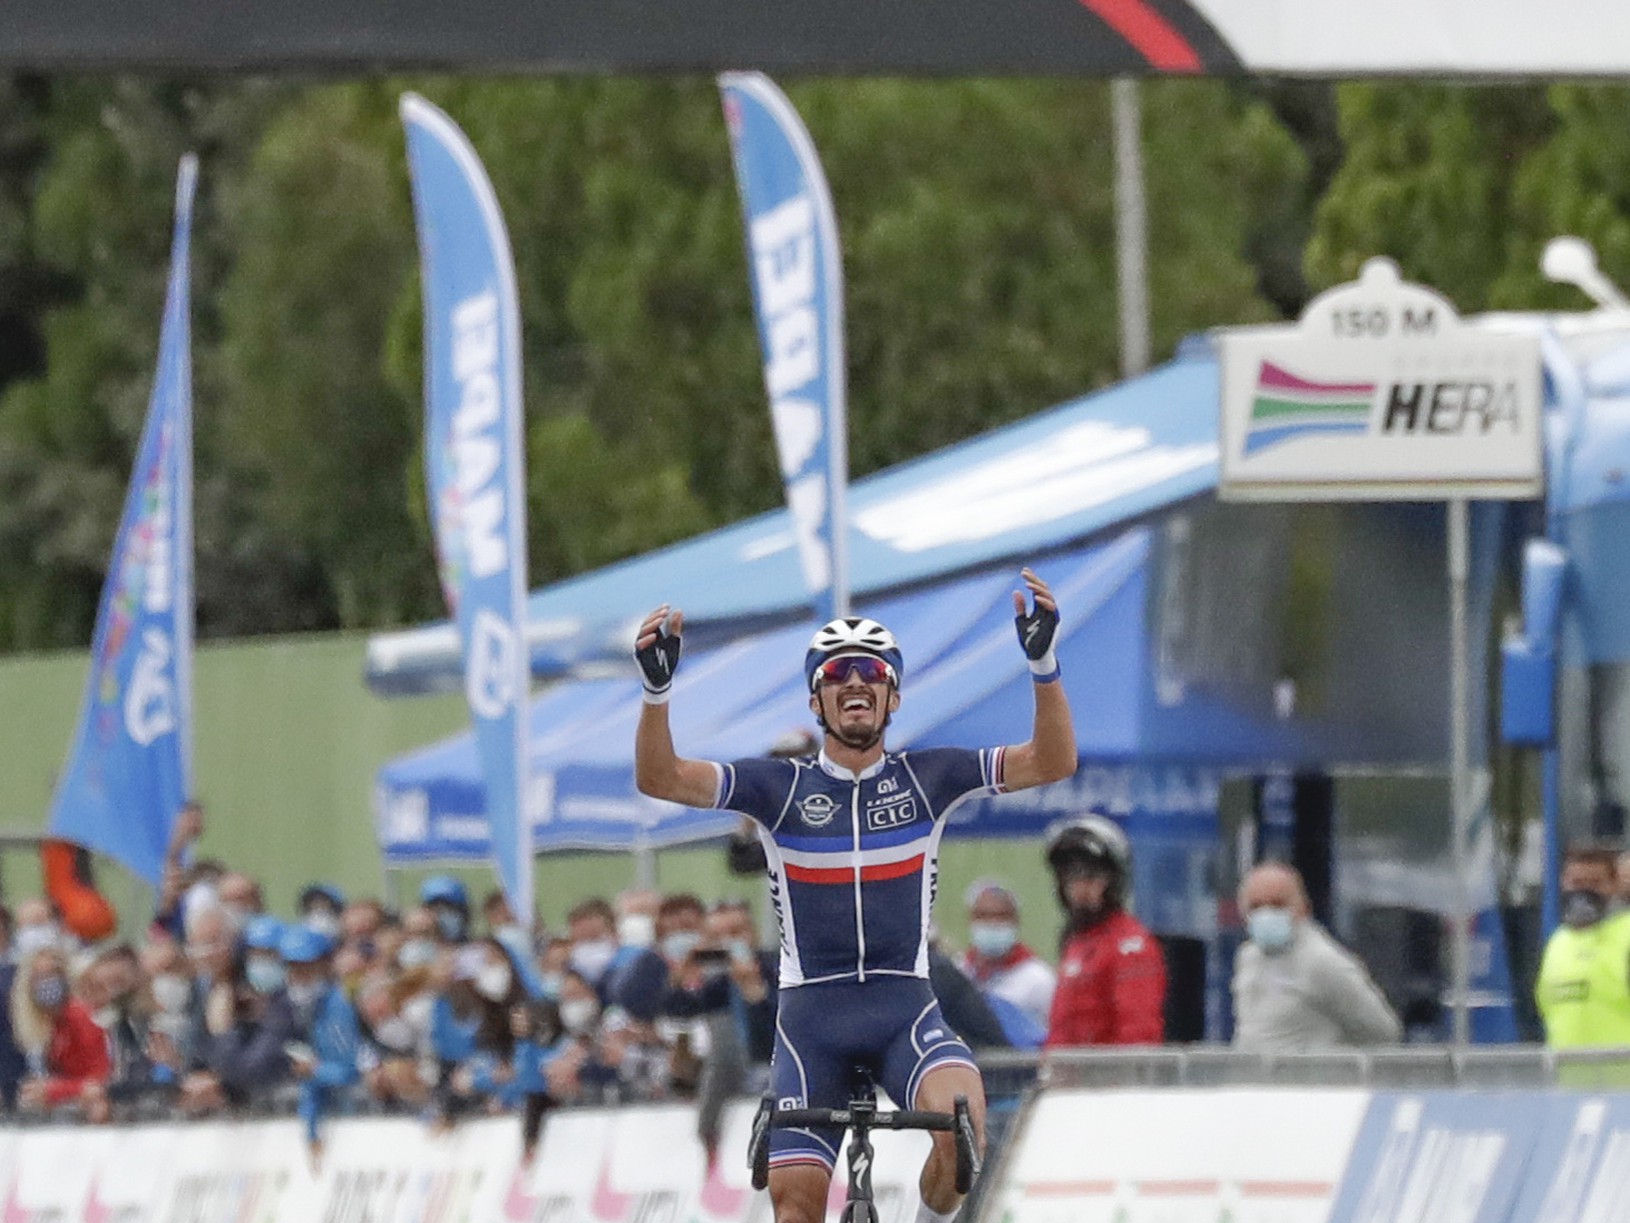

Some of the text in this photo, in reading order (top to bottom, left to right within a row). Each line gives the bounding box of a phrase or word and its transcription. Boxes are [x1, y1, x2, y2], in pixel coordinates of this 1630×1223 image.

[1332, 308, 1435, 338] 150 M
[1382, 381, 1519, 434] HERA
[873, 803, 912, 825] CIC
